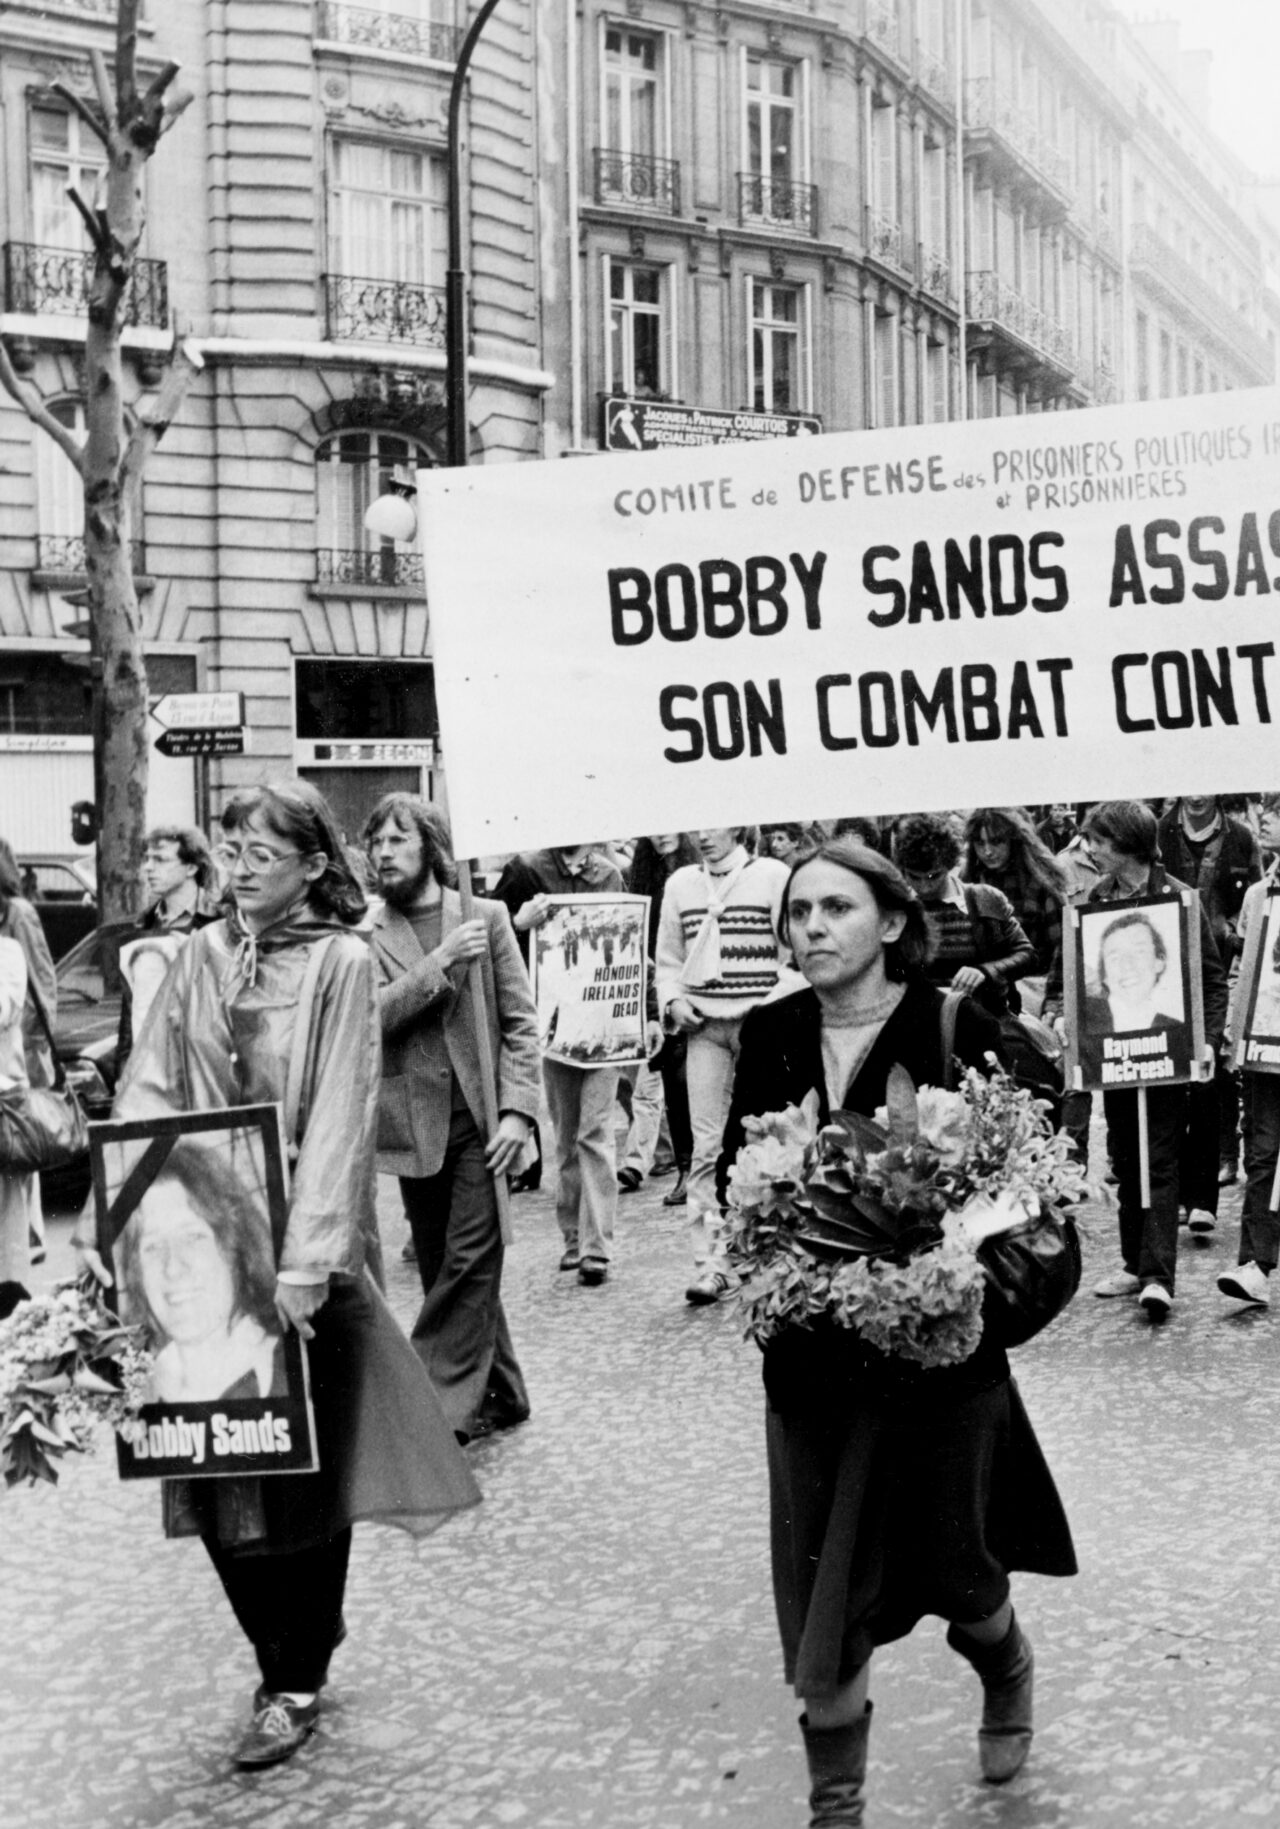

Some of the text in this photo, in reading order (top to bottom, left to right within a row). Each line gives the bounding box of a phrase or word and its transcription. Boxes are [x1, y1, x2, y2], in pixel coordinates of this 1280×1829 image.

[693, 411, 733, 429] PATRICK
[734, 414, 788, 434] COURTOIS
[613, 478, 737, 517] COMITE
[750, 487, 779, 506] de
[799, 454, 948, 503] DEFENSE
[952, 472, 987, 490] des
[992, 440, 1124, 484] PRISONIERS
[1134, 424, 1252, 468] POLITIQUES
[995, 470, 1187, 511] et PRISONNIERES
[606, 550, 828, 646] BOBBY
[861, 530, 1070, 628] SANDS
[658, 678, 788, 764] SON
[814, 656, 1074, 752] COMBAT
[594, 964, 640, 983] HONOUR
[583, 984, 640, 1001] IRELAND'S
[612, 1001, 638, 1018] DEAD
[1103, 1031, 1168, 1061] Raymond
[1101, 1056, 1175, 1084] McCreesh
[211, 1410, 292, 1456] Sands
